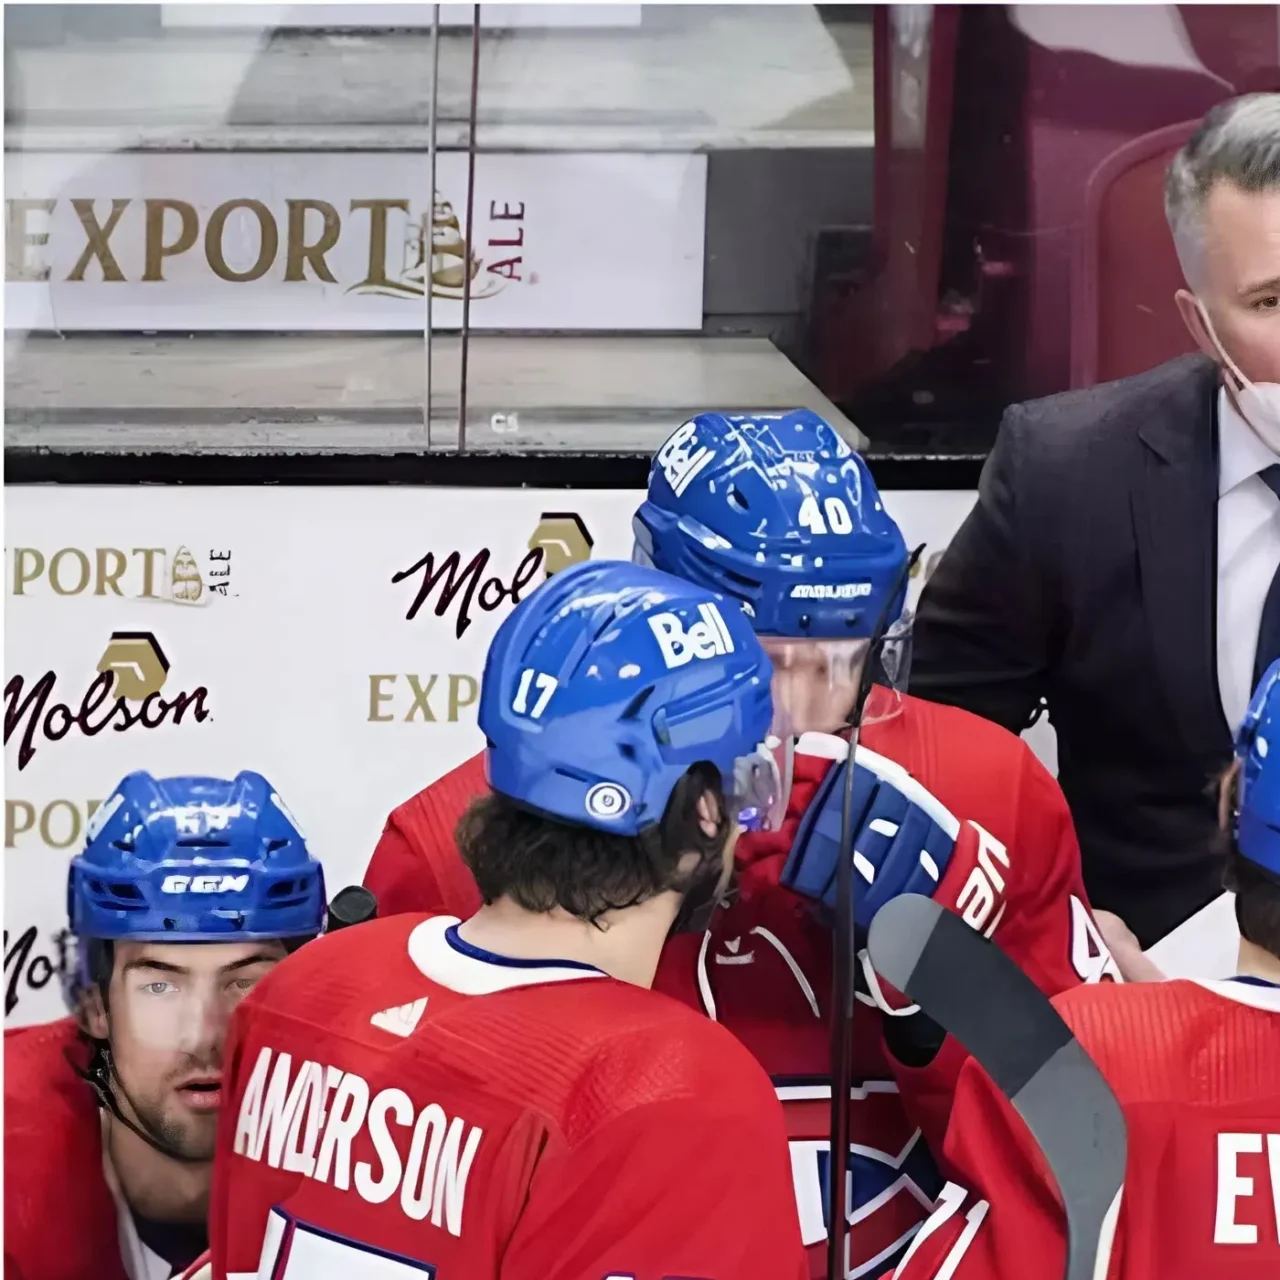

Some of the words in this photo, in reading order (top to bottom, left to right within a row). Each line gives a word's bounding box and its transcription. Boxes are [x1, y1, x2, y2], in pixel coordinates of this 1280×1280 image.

[4, 198, 410, 284] EXPORT
[487, 199, 526, 282] ALE
[798, 497, 853, 535] 40
[12, 546, 167, 597] PORT
[391, 546, 544, 640] Mol
[648, 603, 734, 669] Bell
[4, 669, 210, 772] Molson
[366, 673, 478, 723] EXP
[511, 668, 559, 719] 17
[233, 1046, 483, 1238] ANDERSON
